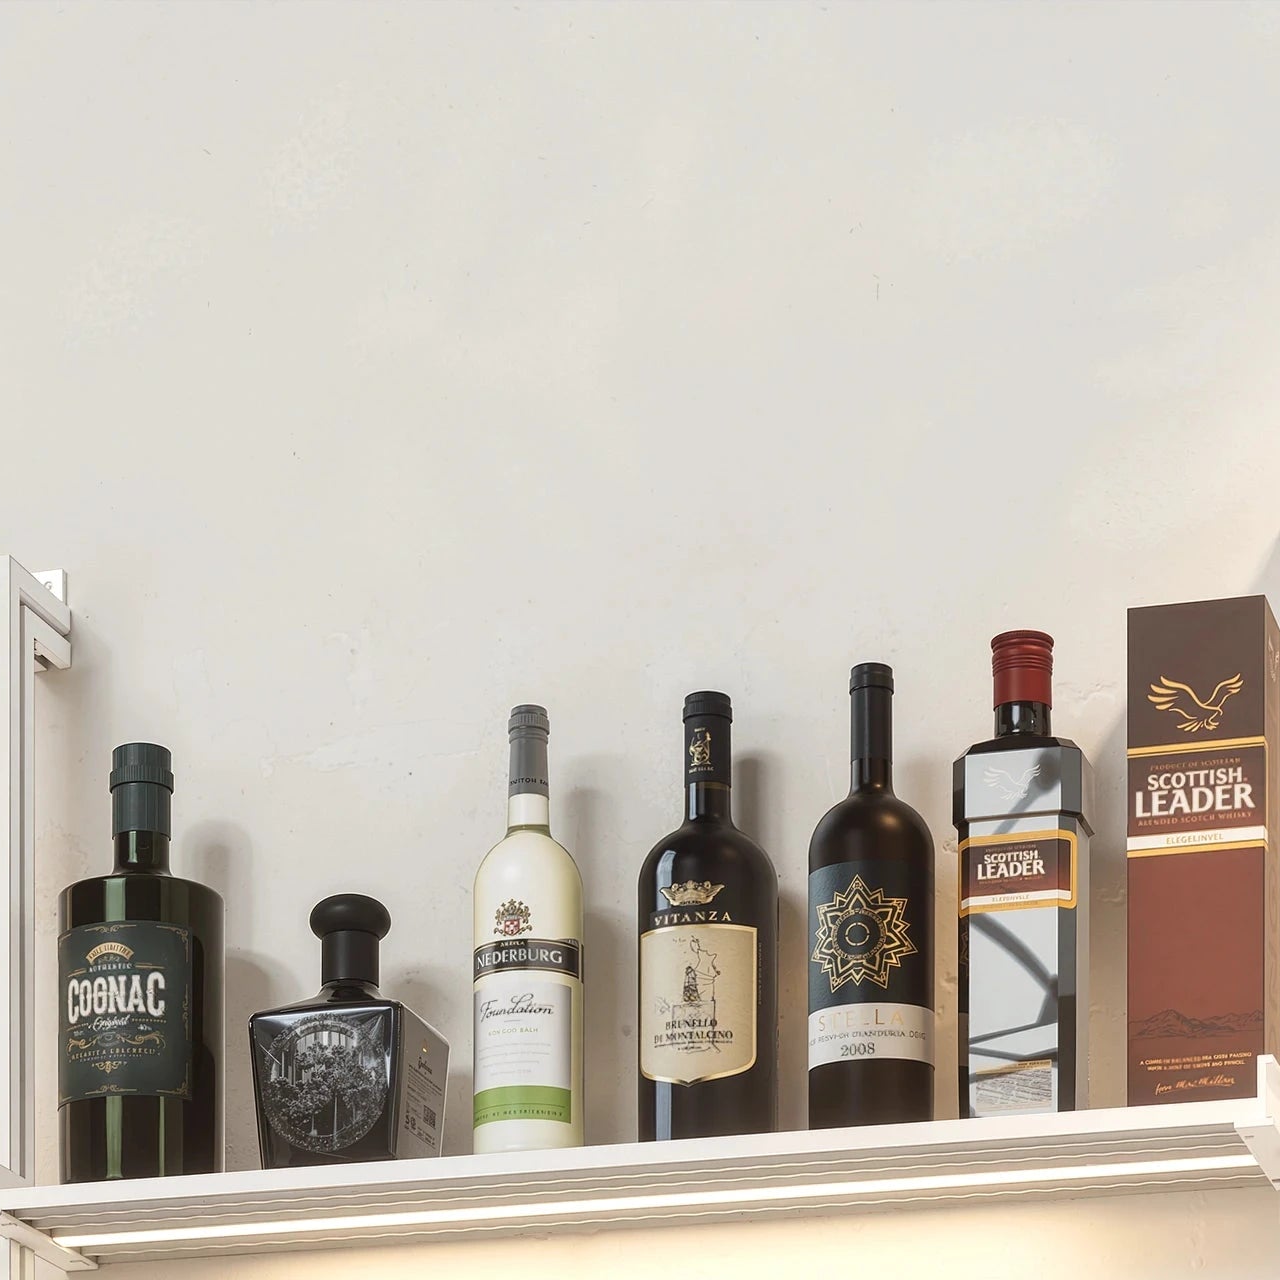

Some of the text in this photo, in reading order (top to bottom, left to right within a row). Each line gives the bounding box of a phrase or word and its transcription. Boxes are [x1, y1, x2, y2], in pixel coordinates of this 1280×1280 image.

[1147, 767, 1243, 791] SCOTTISH
[1136, 783, 1256, 818] LEADER
[984, 850, 1039, 865] SCOTTISH
[977, 860, 1046, 880] LEADER
[654, 910, 732, 926] VITANZA
[477, 948, 563, 970] NEDERBURG
[67, 971, 166, 1024] COGNAC
[480, 994, 555, 1023] Foundation
[840, 1042, 876, 1057] 2008
